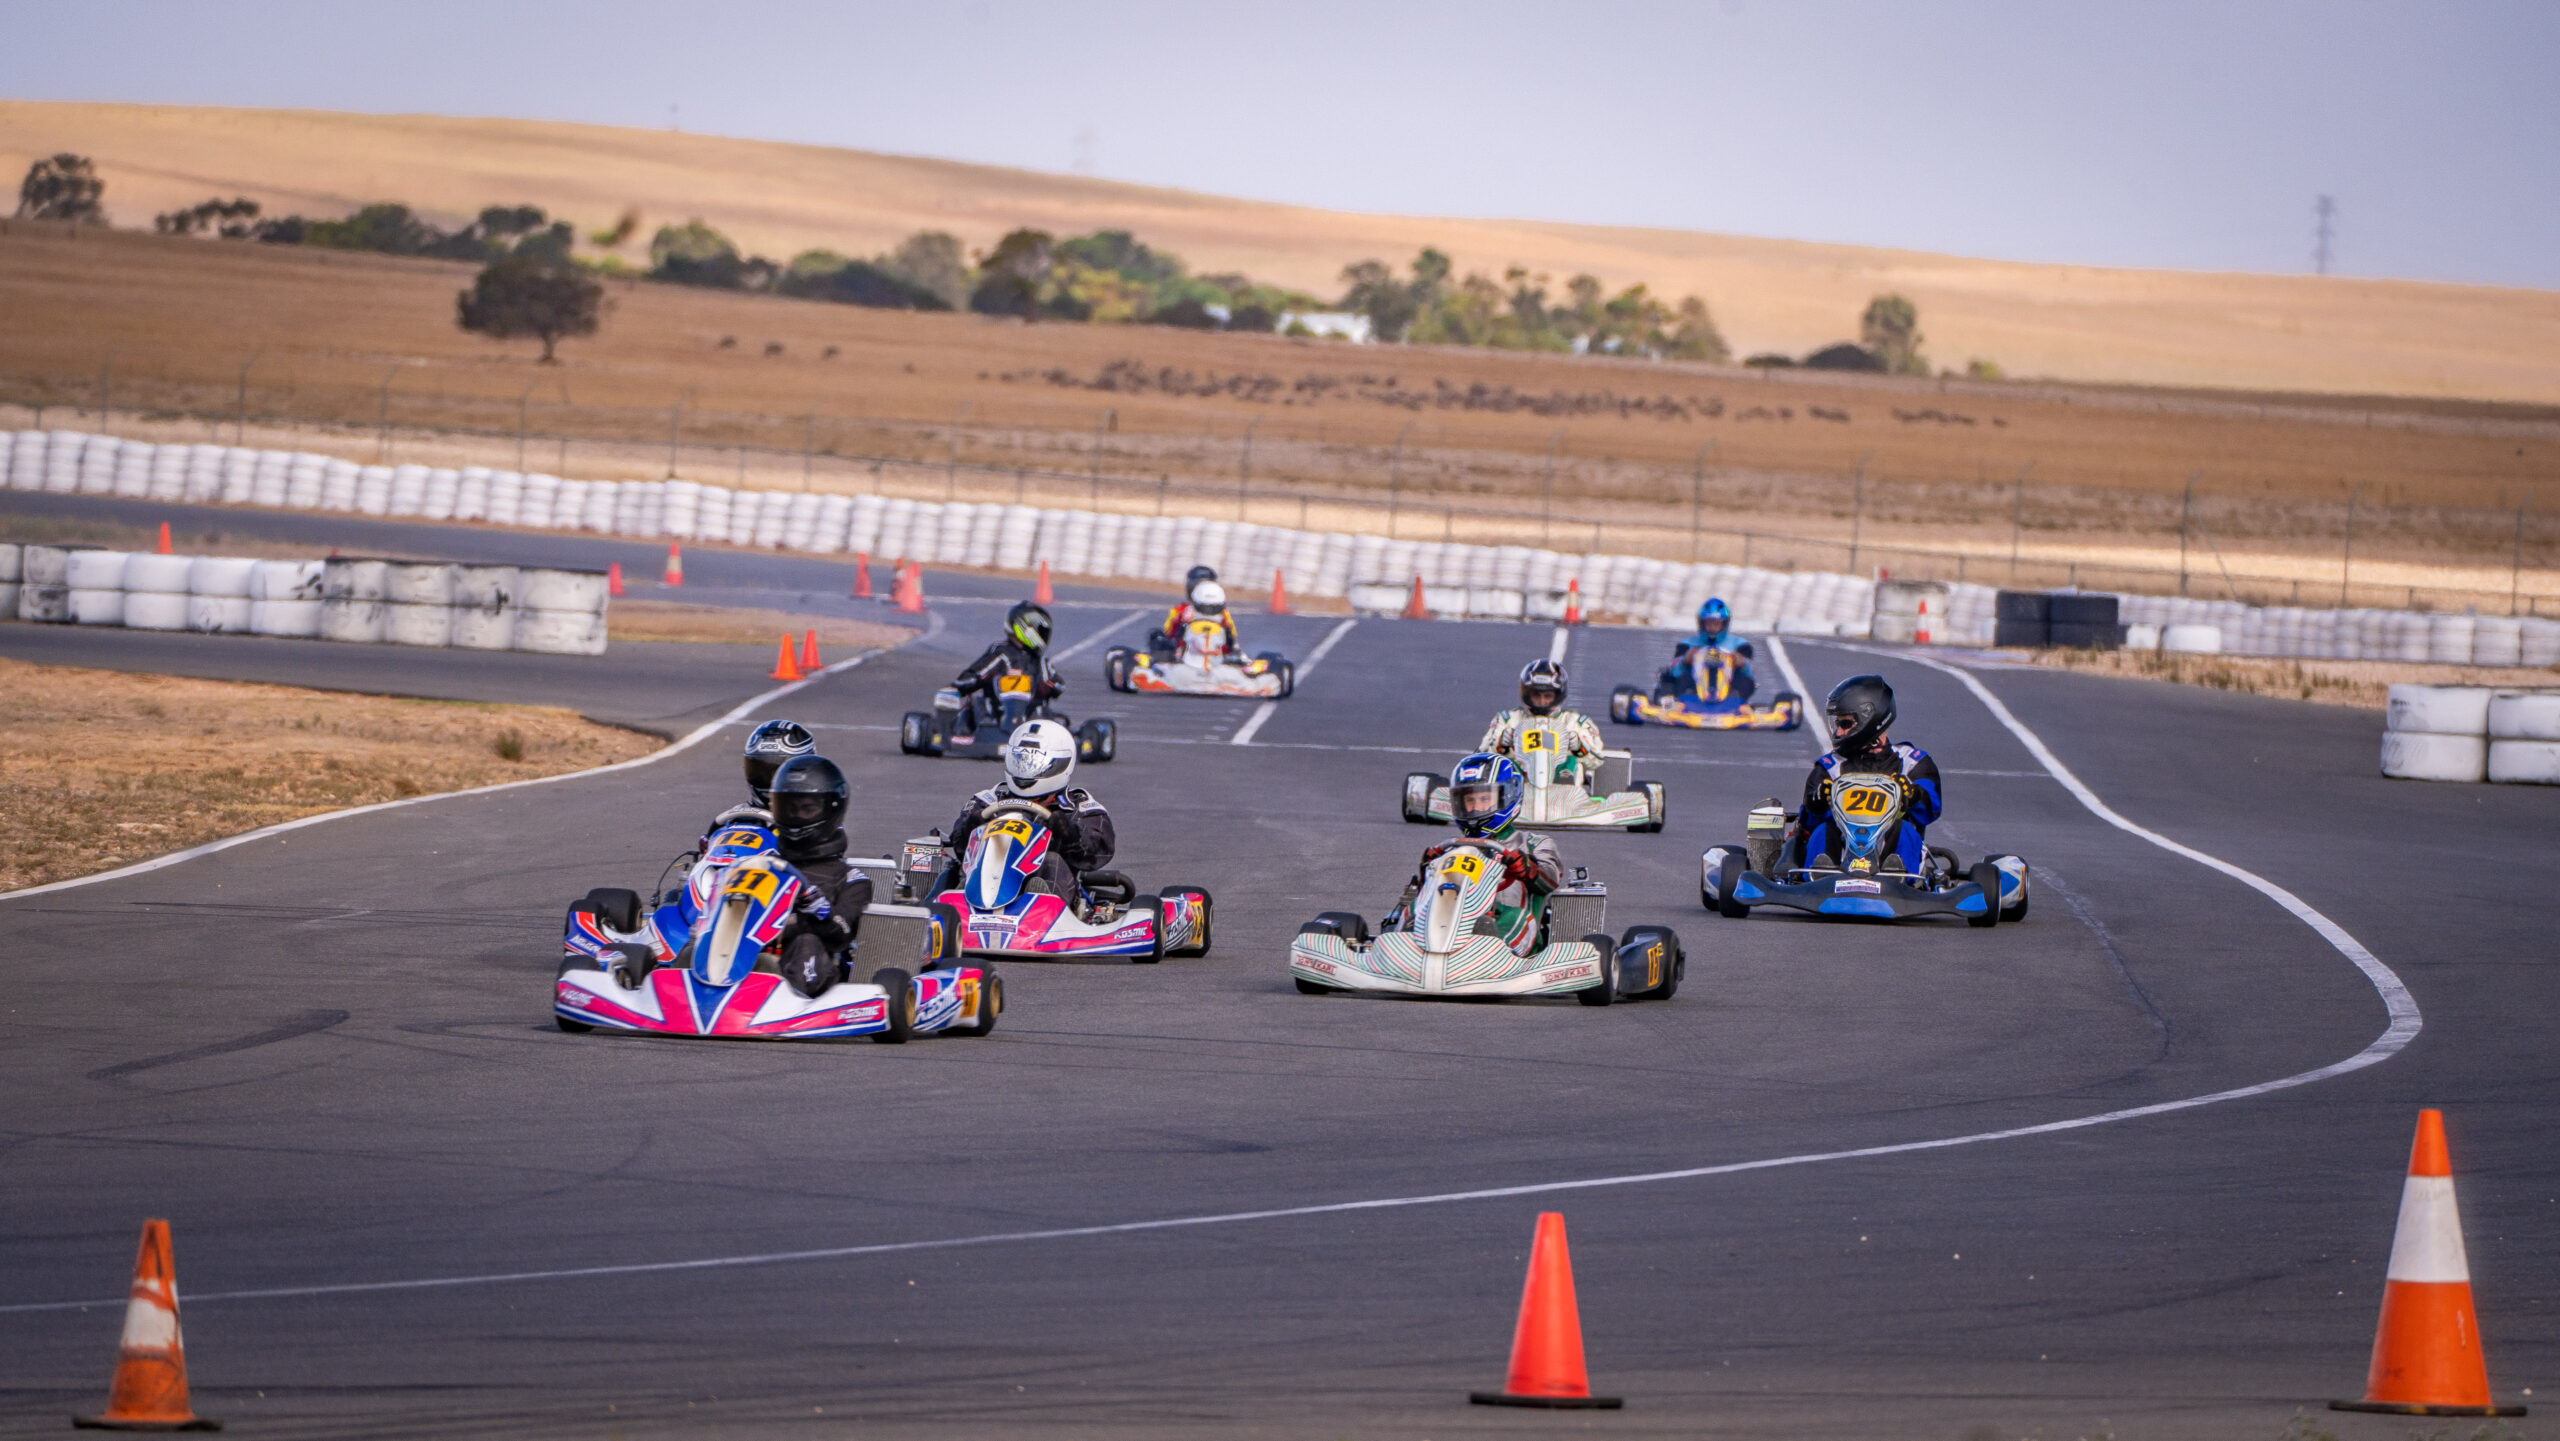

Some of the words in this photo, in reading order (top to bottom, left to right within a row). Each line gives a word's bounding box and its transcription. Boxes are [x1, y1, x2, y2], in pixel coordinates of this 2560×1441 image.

[1527, 732, 1541, 749] 3
[1846, 790, 1886, 812] 20
[988, 820, 1027, 835] 33
[719, 832, 760, 846] 14
[904, 844, 942, 855] EXPRIT
[726, 869, 770, 891] 41
